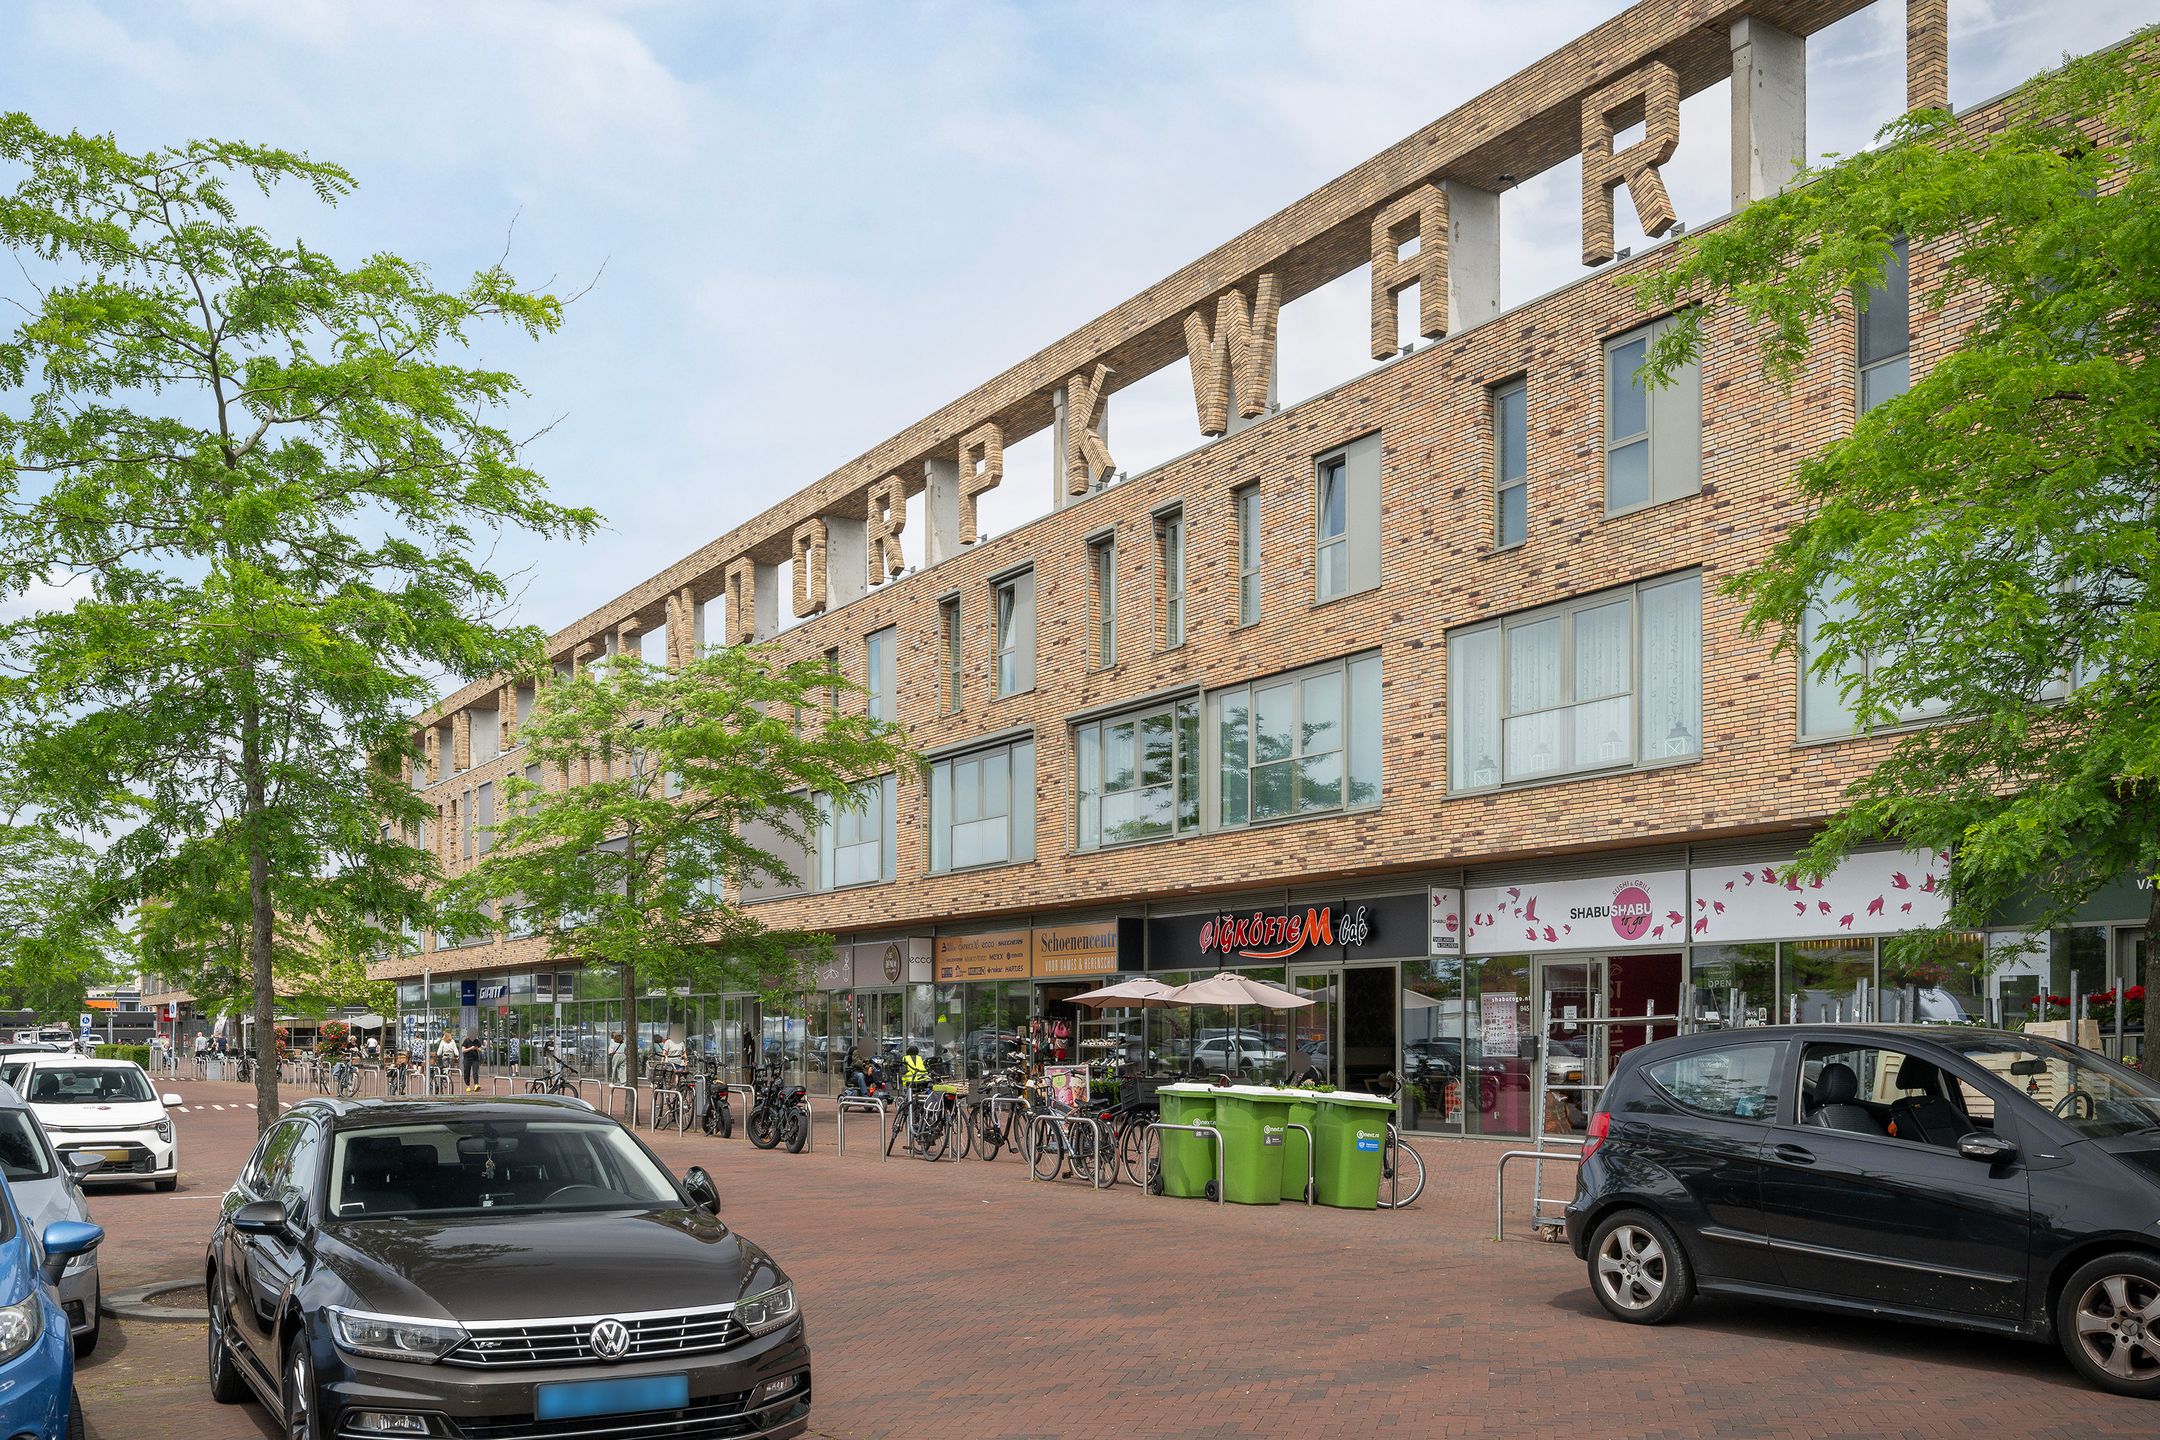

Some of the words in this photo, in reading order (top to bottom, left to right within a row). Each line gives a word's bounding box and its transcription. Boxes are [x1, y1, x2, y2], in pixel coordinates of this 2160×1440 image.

[1612, 880, 1629, 896] SUSHI
[1634, 880, 1651, 894] GRILL
[1708, 979, 1731, 988] OPEN
[480, 985, 504, 999] GIANT
